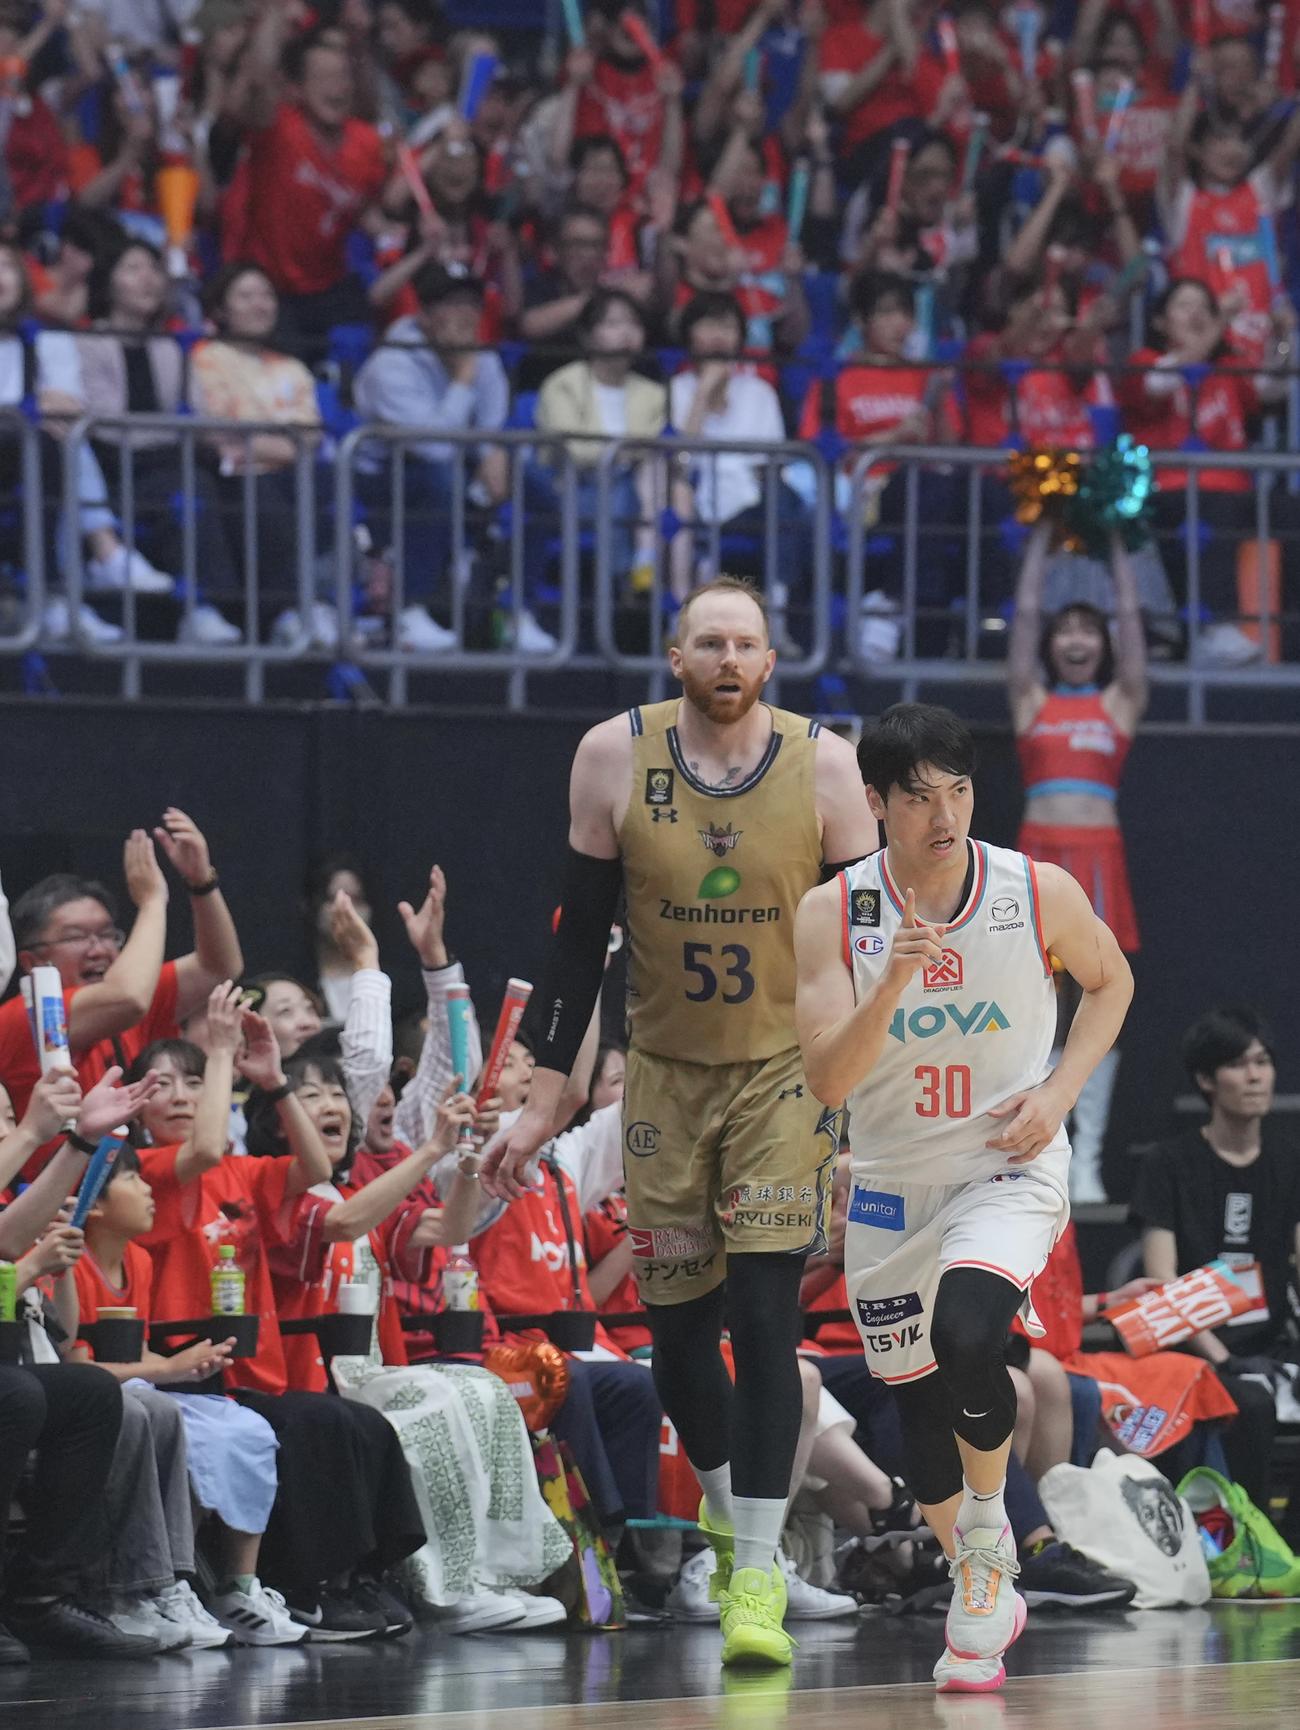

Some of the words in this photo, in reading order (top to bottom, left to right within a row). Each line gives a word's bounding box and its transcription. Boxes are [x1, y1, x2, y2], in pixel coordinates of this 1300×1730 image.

[660, 900, 780, 923] Zenhoren
[988, 921, 1025, 933] mazda
[683, 941, 755, 1004] 53
[923, 985, 964, 994] DRAGONFLIES
[914, 1064, 971, 1118] 30
[734, 1213, 812, 1227] RYUSEKI
[643, 1254, 717, 1281] ナンセイ
[865, 1311, 904, 1325] Engineer
